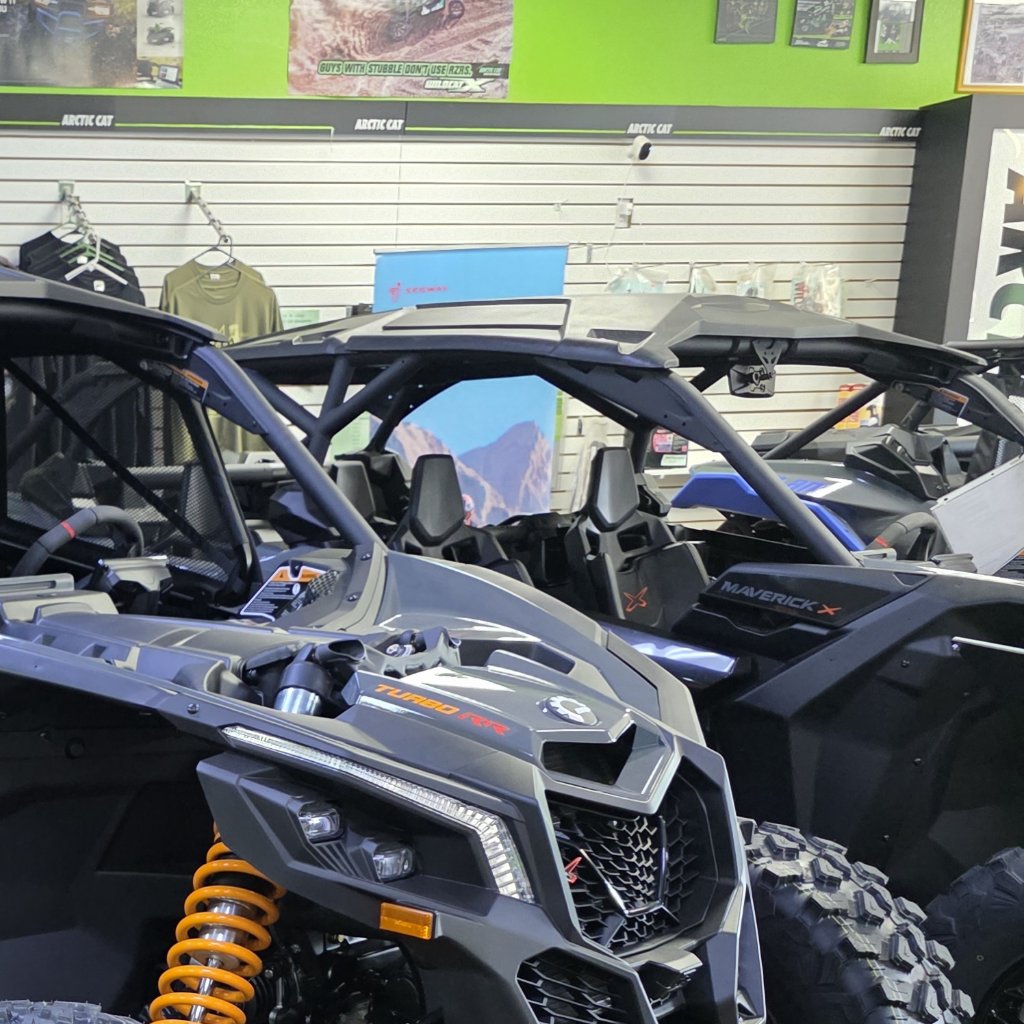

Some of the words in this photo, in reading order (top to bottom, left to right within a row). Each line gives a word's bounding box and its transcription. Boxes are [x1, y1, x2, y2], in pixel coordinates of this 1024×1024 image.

[319, 62, 342, 74] GUYS
[344, 62, 366, 74] WITH
[367, 62, 403, 75] STUBBLE
[404, 63, 430, 76] DON'T
[430, 64, 447, 75] USE
[61, 114, 95, 126] ARCTIC
[95, 114, 114, 127] CAT
[354, 118, 386, 131] ARCTIC
[386, 119, 405, 131] CAT
[626, 123, 657, 134] ARCTIC
[656, 123, 673, 134] CAT
[879, 126, 907, 137] ARCTIC
[906, 127, 922, 137] CAT
[720, 580, 818, 612] MAVERICK
[374, 683, 460, 715] TURBO
